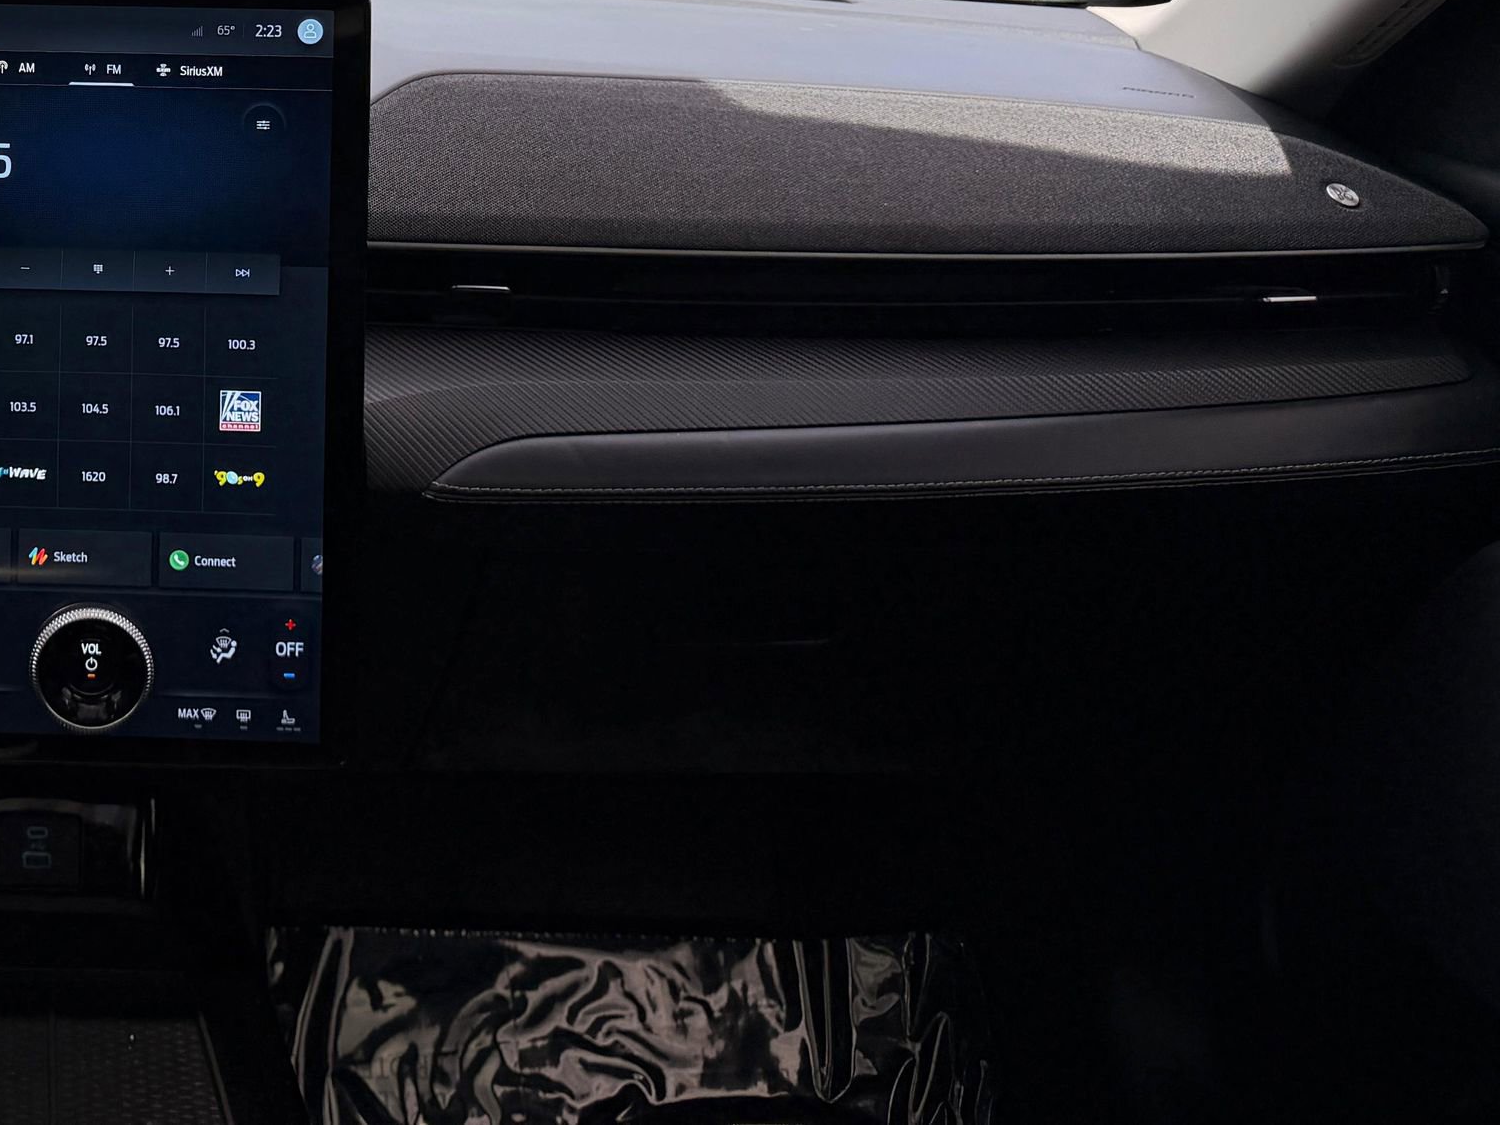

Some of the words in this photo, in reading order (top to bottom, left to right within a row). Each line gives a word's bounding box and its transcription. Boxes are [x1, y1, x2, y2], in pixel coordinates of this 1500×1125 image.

[255, 24, 282, 38] 2:23
[18, 62, 35, 73] AM
[106, 64, 122, 75] FM
[179, 65, 223, 77] SiriusXM
[14, 333, 34, 345] 97.1
[85, 335, 108, 347] 97.5
[158, 337, 180, 348] 97.5
[227, 339, 256, 350] 100.3
[9, 401, 37, 413] 103.5
[81, 403, 109, 415] 104.5
[155, 405, 180, 416] 106.1
[233, 399, 259, 412] FOX
[226, 411, 259, 422] NEWS
[81, 470, 106, 482] 1620
[155, 473, 178, 484] 98.7
[53, 550, 88, 563] Sketch
[194, 555, 236, 568] Connect
[81, 642, 102, 655] VOL
[275, 641, 304, 657] OFF
[177, 707, 199, 719] MAX
